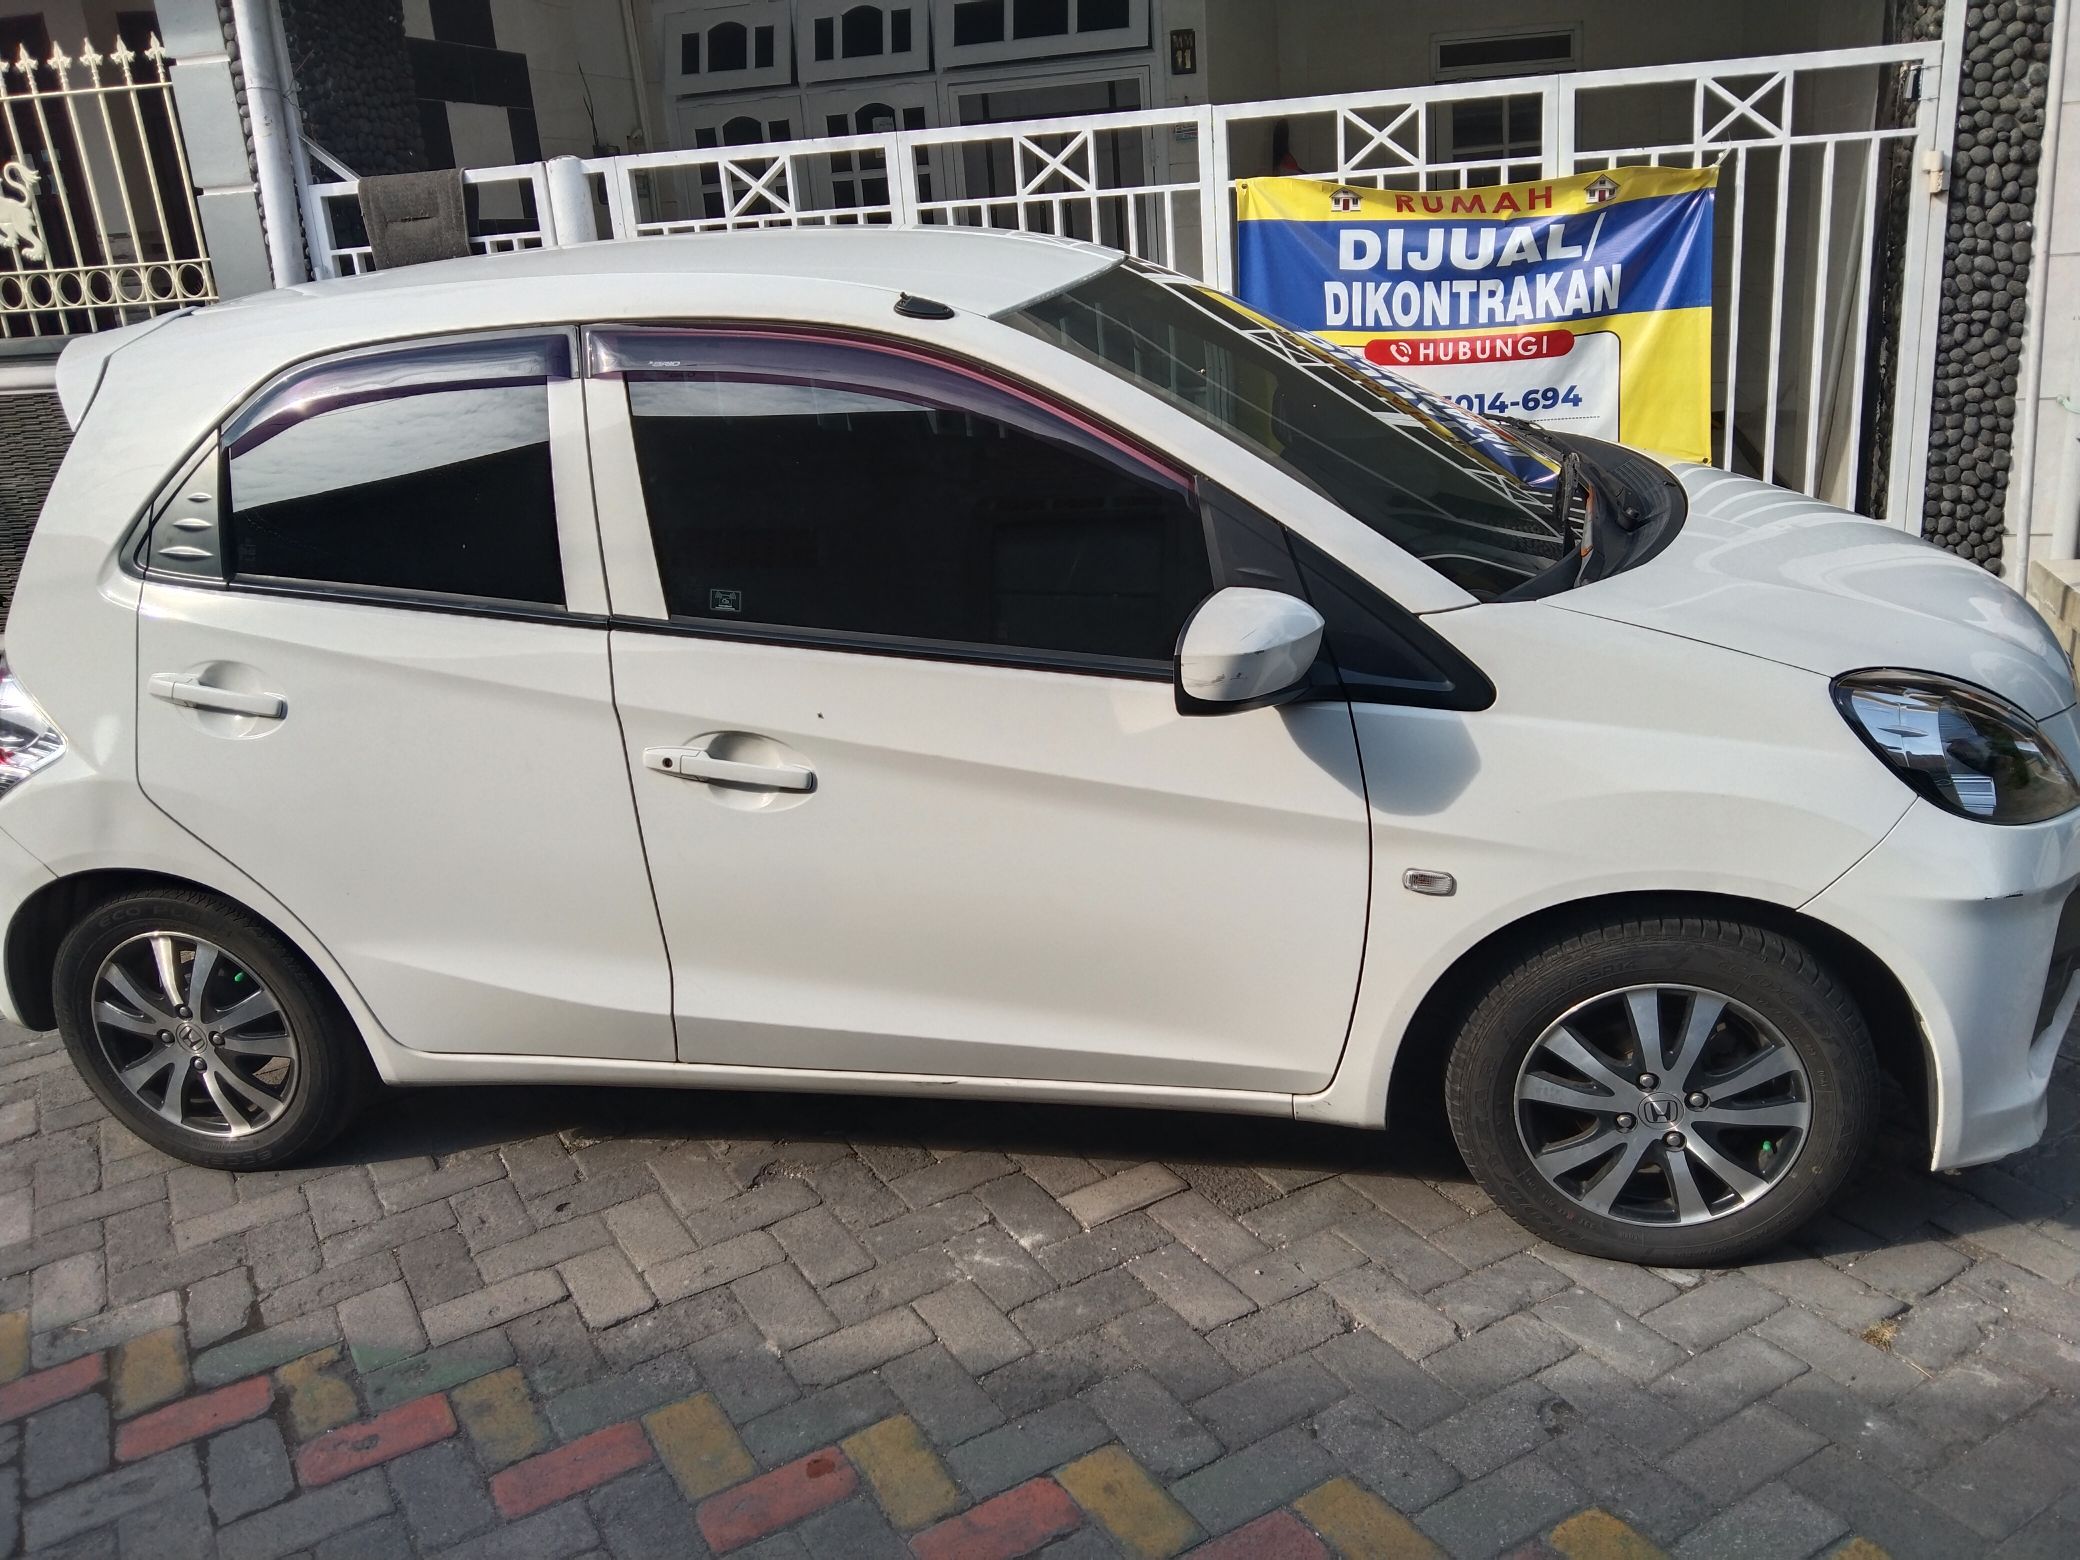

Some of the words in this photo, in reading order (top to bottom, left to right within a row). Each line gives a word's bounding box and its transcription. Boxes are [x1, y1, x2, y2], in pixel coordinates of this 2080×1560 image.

[1395, 187, 1553, 213] RUMAH
[1339, 212, 1606, 271] DIJUAL/
[1324, 263, 1622, 327] DIKONTRAKAN
[1419, 336, 1548, 362] HUBUNGI
[1449, 384, 1583, 415] 014-694
